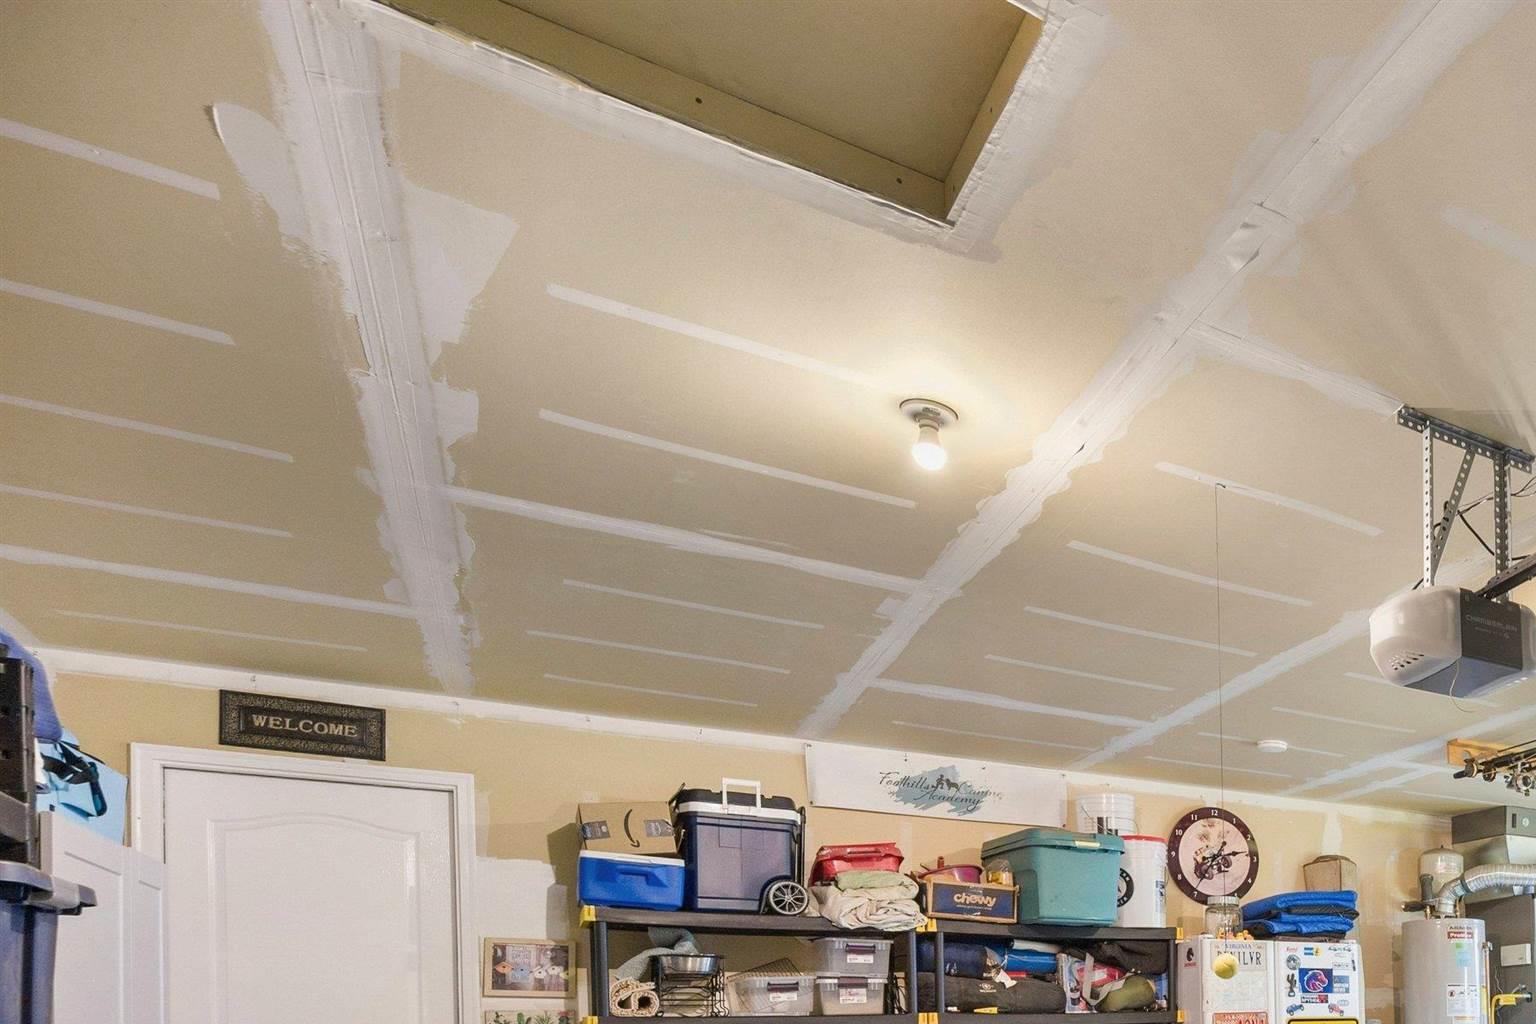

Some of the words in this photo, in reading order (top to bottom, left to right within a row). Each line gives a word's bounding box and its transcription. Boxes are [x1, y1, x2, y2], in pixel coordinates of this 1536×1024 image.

[252, 714, 358, 738] WELCOME
[879, 771, 934, 791] Foothills
[913, 788, 982, 813] Academy
[953, 892, 997, 908] chewy
